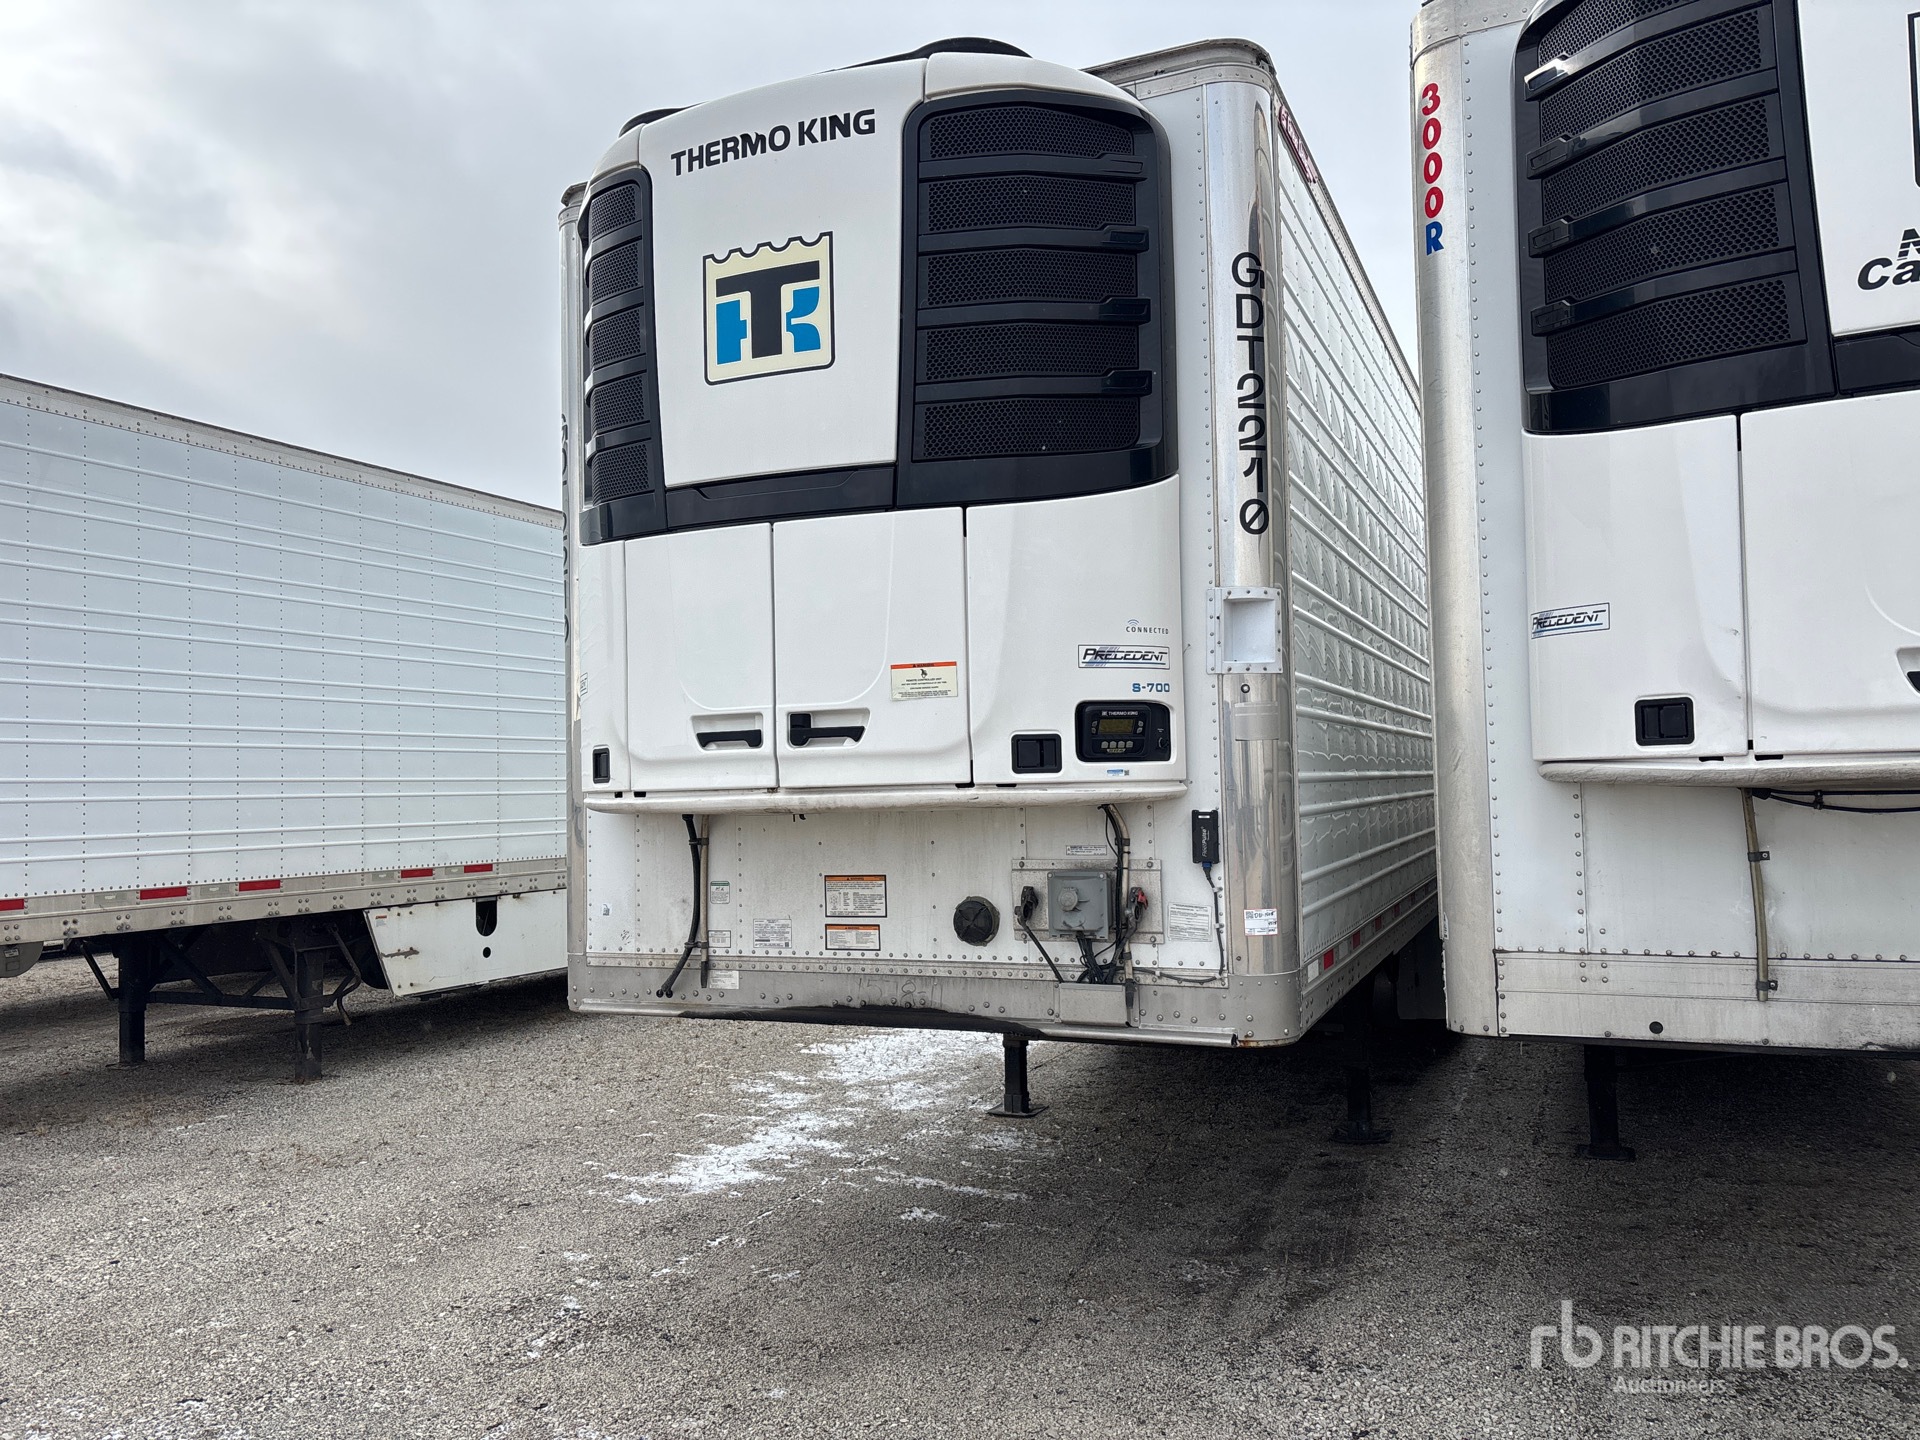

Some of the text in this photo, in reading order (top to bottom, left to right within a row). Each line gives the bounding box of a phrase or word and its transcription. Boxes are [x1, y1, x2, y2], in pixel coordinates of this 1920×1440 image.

[671, 109, 876, 177] THERMO KING
[1422, 83, 1444, 256] 3000R
[1125, 626, 1169, 635] CONNECTED
[1083, 648, 1168, 661] PRECEDENT
[1132, 683, 1170, 692] S-700
